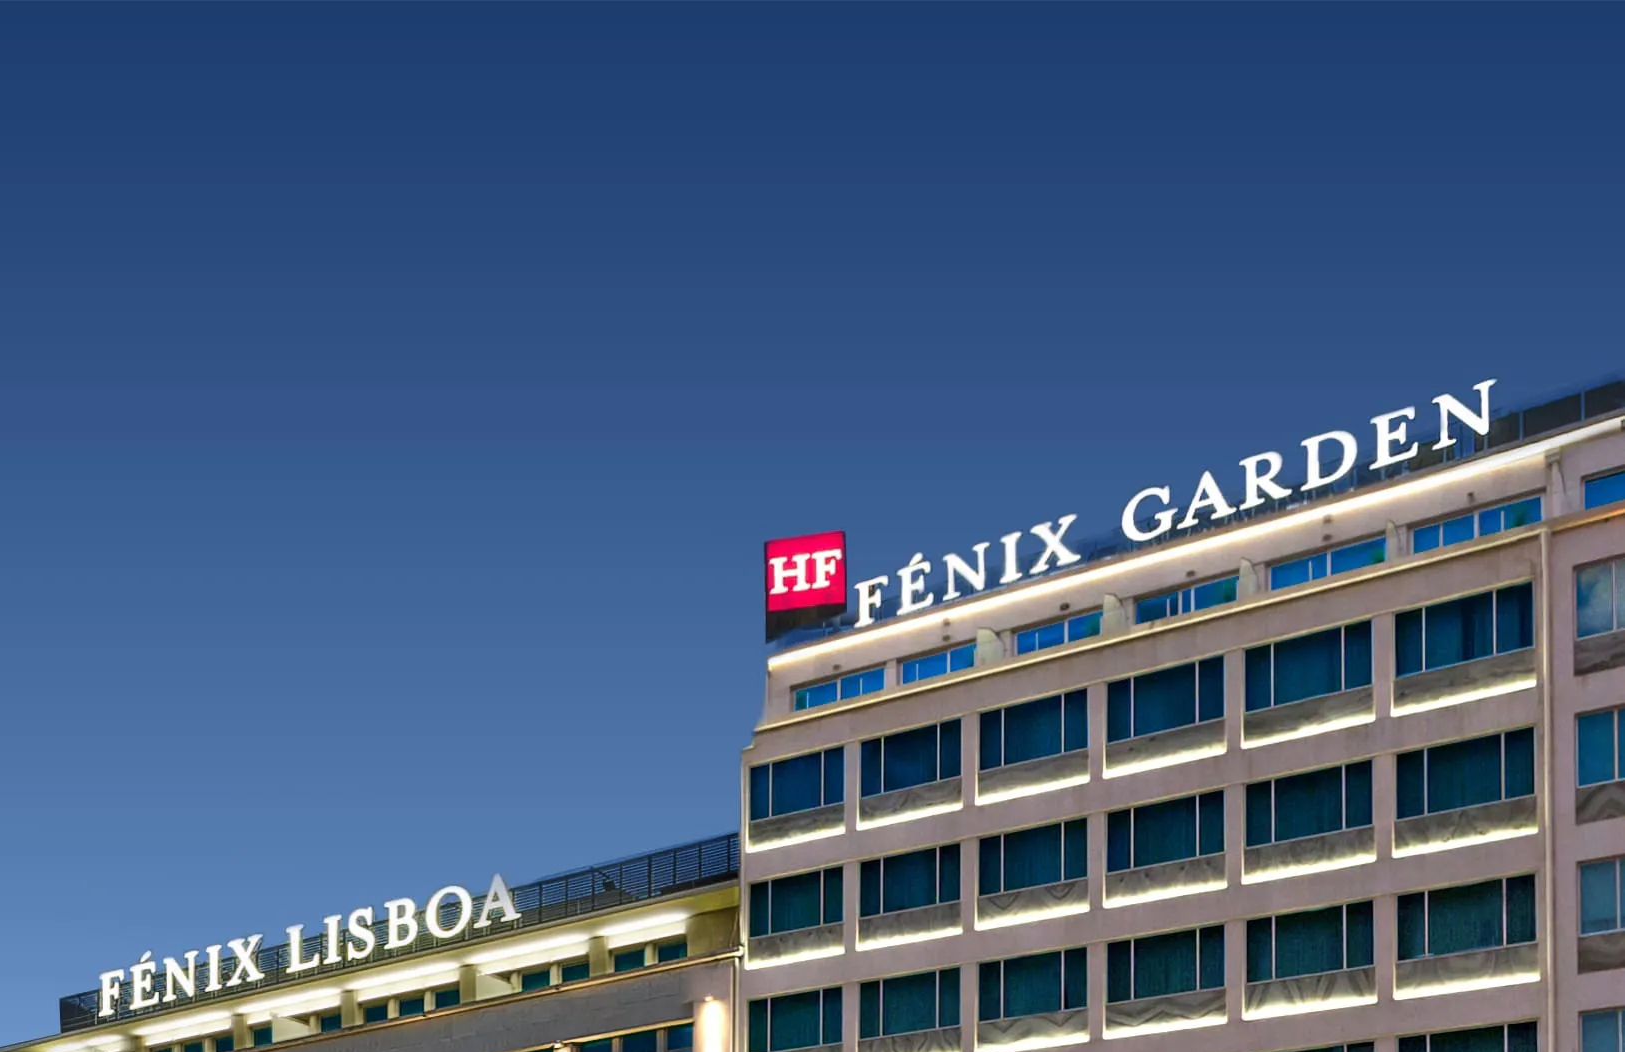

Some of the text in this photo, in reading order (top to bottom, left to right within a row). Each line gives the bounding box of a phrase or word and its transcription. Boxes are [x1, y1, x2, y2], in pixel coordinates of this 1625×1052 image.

[768, 378, 1498, 630] HF FÉNIX GARDEN
[97, 872, 523, 1018] FÉNIX LISBOA
